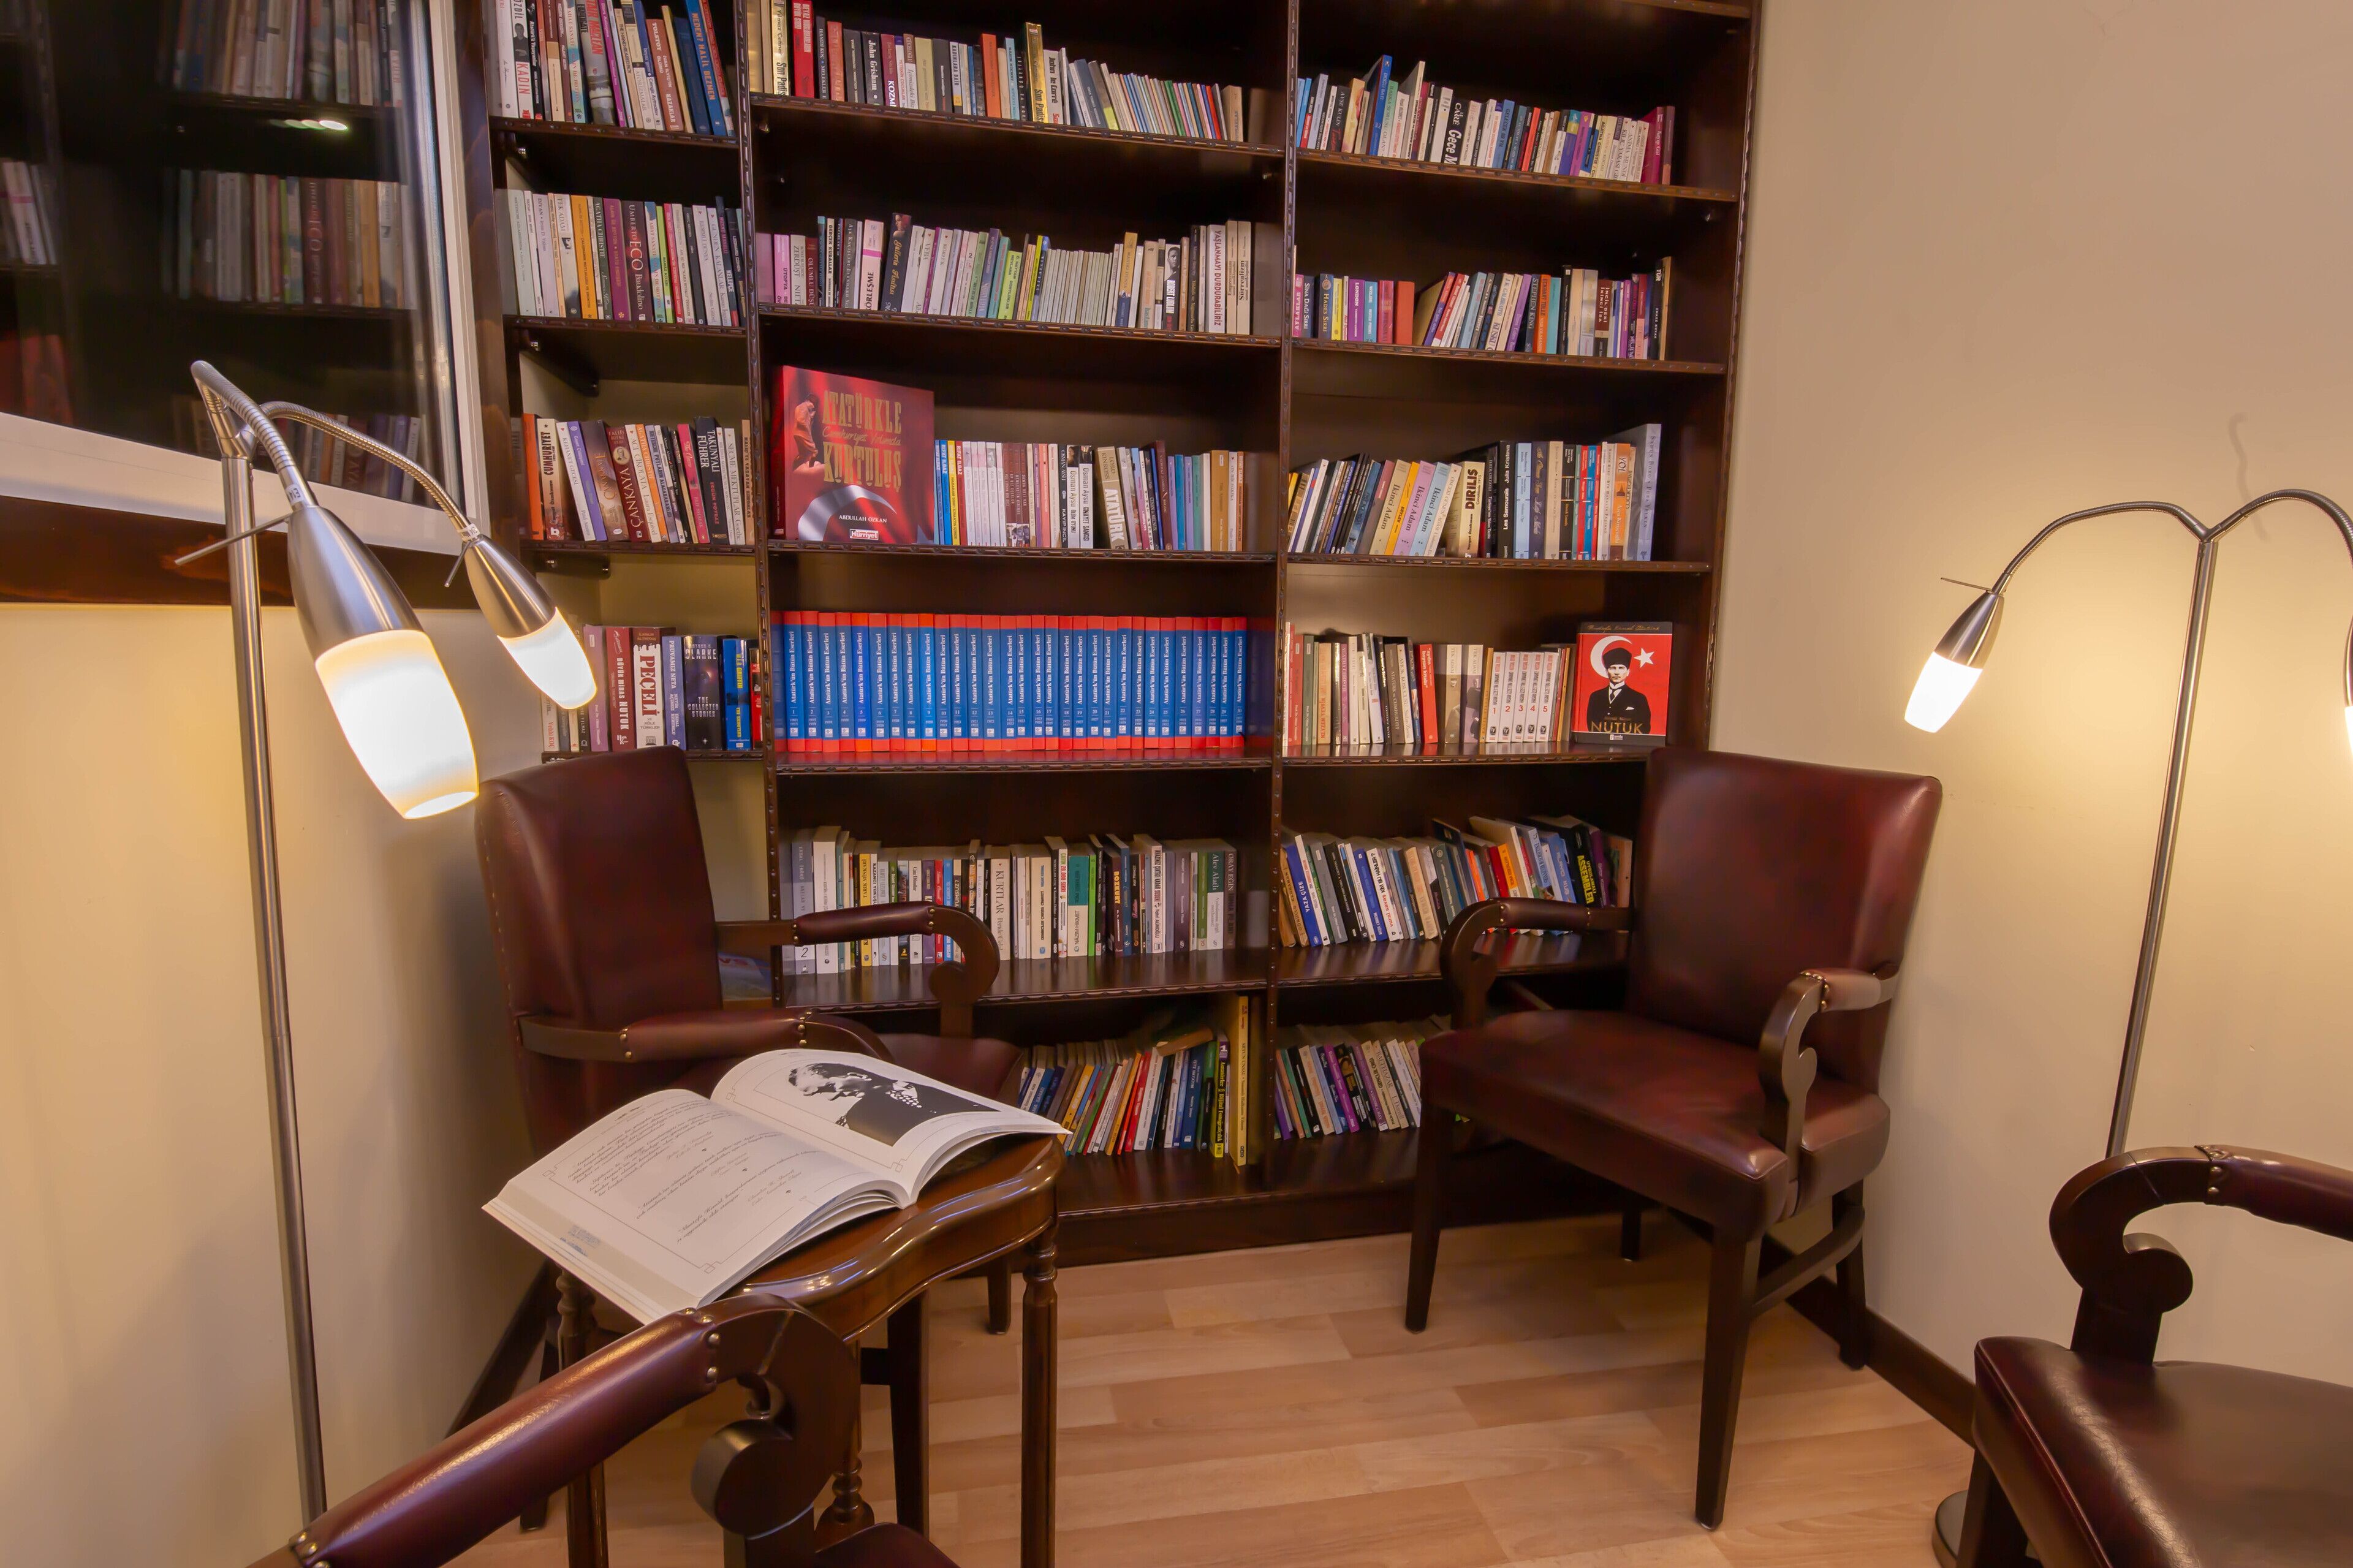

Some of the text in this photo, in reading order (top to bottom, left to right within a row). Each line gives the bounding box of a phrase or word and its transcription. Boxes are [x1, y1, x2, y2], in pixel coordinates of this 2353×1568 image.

[652, 22, 662, 51] TOLSTOY
[517, 63, 530, 94] KADIN
[704, 70, 715, 100] BEZMEN
[1446, 130, 1461, 154] Gece
[629, 241, 643, 270] ECO
[635, 274, 646, 309] Baudolino
[1214, 273, 1222, 326] DURDURABİLİRİZ
[1529, 278, 1539, 310] STEPHEN
[697, 435, 710, 468] FÜHRER
[707, 430, 720, 472] TAKUNYALI
[1618, 456, 1627, 473] YOL
[823, 441, 901, 493] KURTULUŞ
[620, 468, 643, 528] ÇANKAYA
[1104, 488, 1124, 542] ATATÜRK
[1381, 507, 1392, 529] Adam
[1406, 509, 1416, 531] Adam
[1421, 510, 1433, 532] Adam
[640, 656, 659, 716] PEÇELİ
[620, 701, 629, 730] NUTUK
[1591, 721, 1643, 733] NUTUK
[996, 871, 1004, 914] KURTLAR
[1577, 855, 1594, 904] ASSEMBLER
[801, 948, 808, 958] 2
